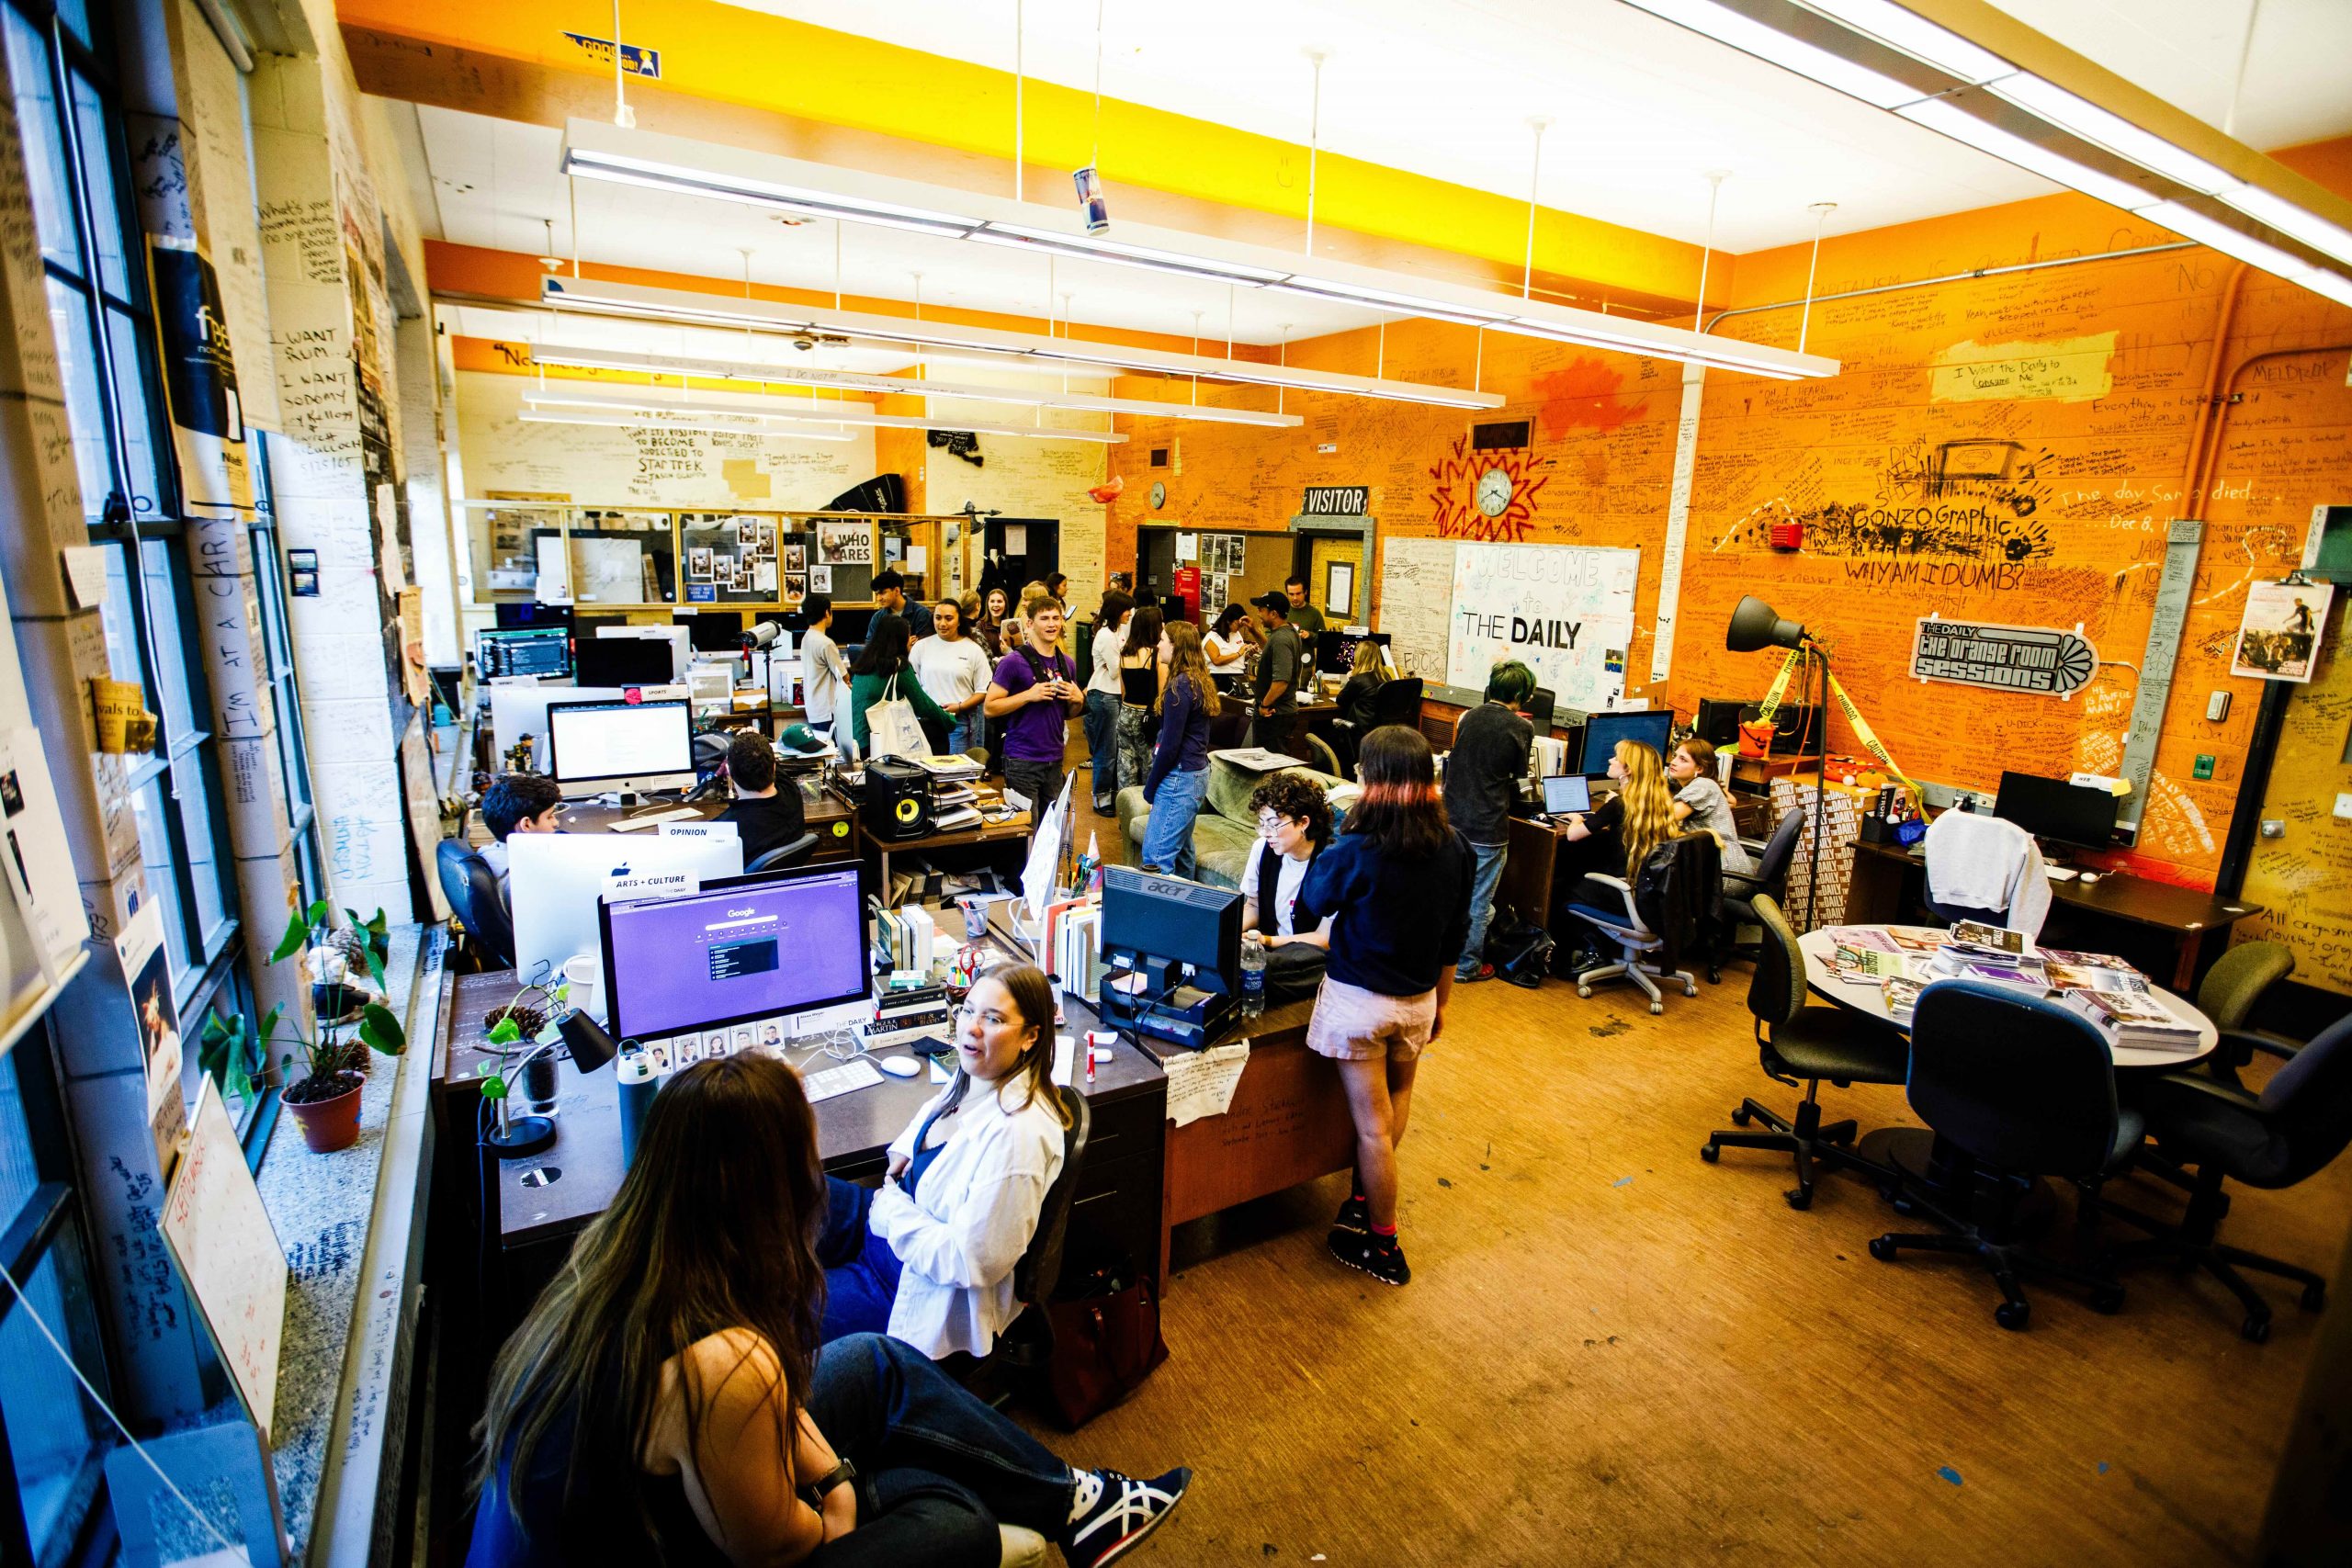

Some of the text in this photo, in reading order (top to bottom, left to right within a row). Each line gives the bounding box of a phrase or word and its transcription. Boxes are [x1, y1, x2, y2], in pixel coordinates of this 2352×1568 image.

[286, 328, 337, 345] WANT
[1954, 367, 1963, 378] I
[1999, 363, 2016, 373] the
[2021, 359, 2047, 372] Daily
[2050, 359, 2060, 368] to
[300, 371, 348, 387] WANT
[2093, 398, 2156, 413] Everything
[651, 438, 695, 447] BECOME
[639, 447, 704, 457] ADDICTED TO
[639, 457, 704, 473] STAR TREK
[2058, 479, 2147, 506] The day
[1308, 489, 1363, 513] VISITOR
[838, 534, 869, 547] WHO
[832, 548, 870, 561] CARES
[1477, 547, 1600, 587] WELCOME
[1792, 575, 1837, 585] never
[1892, 559, 1920, 583] AM
[1921, 561, 1939, 585] I
[1942, 561, 2025, 592] DUMB?
[216, 616, 240, 633] A
[1463, 612, 1582, 649] THE DAILY
[1950, 637, 2009, 665] orange
[2010, 644, 2059, 671] room
[1917, 656, 2054, 691] sessions
[2091, 685, 2105, 695] HE
[2085, 691, 2132, 706] IS AWFUL
[98, 703, 140, 716] vals to
[1759, 691, 1858, 721] CAUTION CUIDADO
[1866, 739, 1891, 765] CAUTION
[1775, 784, 1794, 795] DAILY
[1777, 795, 1796, 807] DAILY
[1832, 798, 1853, 810] DAILY
[1835, 810, 1855, 822] DAILY
[1837, 822, 1859, 834] DAILY
[616, 879, 639, 888] ARTS
[648, 875, 686, 886] CULTURE
[1148, 881, 1186, 897] acer
[1821, 884, 1841, 896] DAILY
[1824, 895, 1844, 908] DAILY
[728, 907, 756, 918] Google
[1826, 907, 1846, 919] DAILY
[2260, 908, 2286, 926] All
[2265, 928, 2315, 952] novelty
[848, 1017, 867, 1027] DAILY
[866, 1022, 899, 1035] MARTIN
